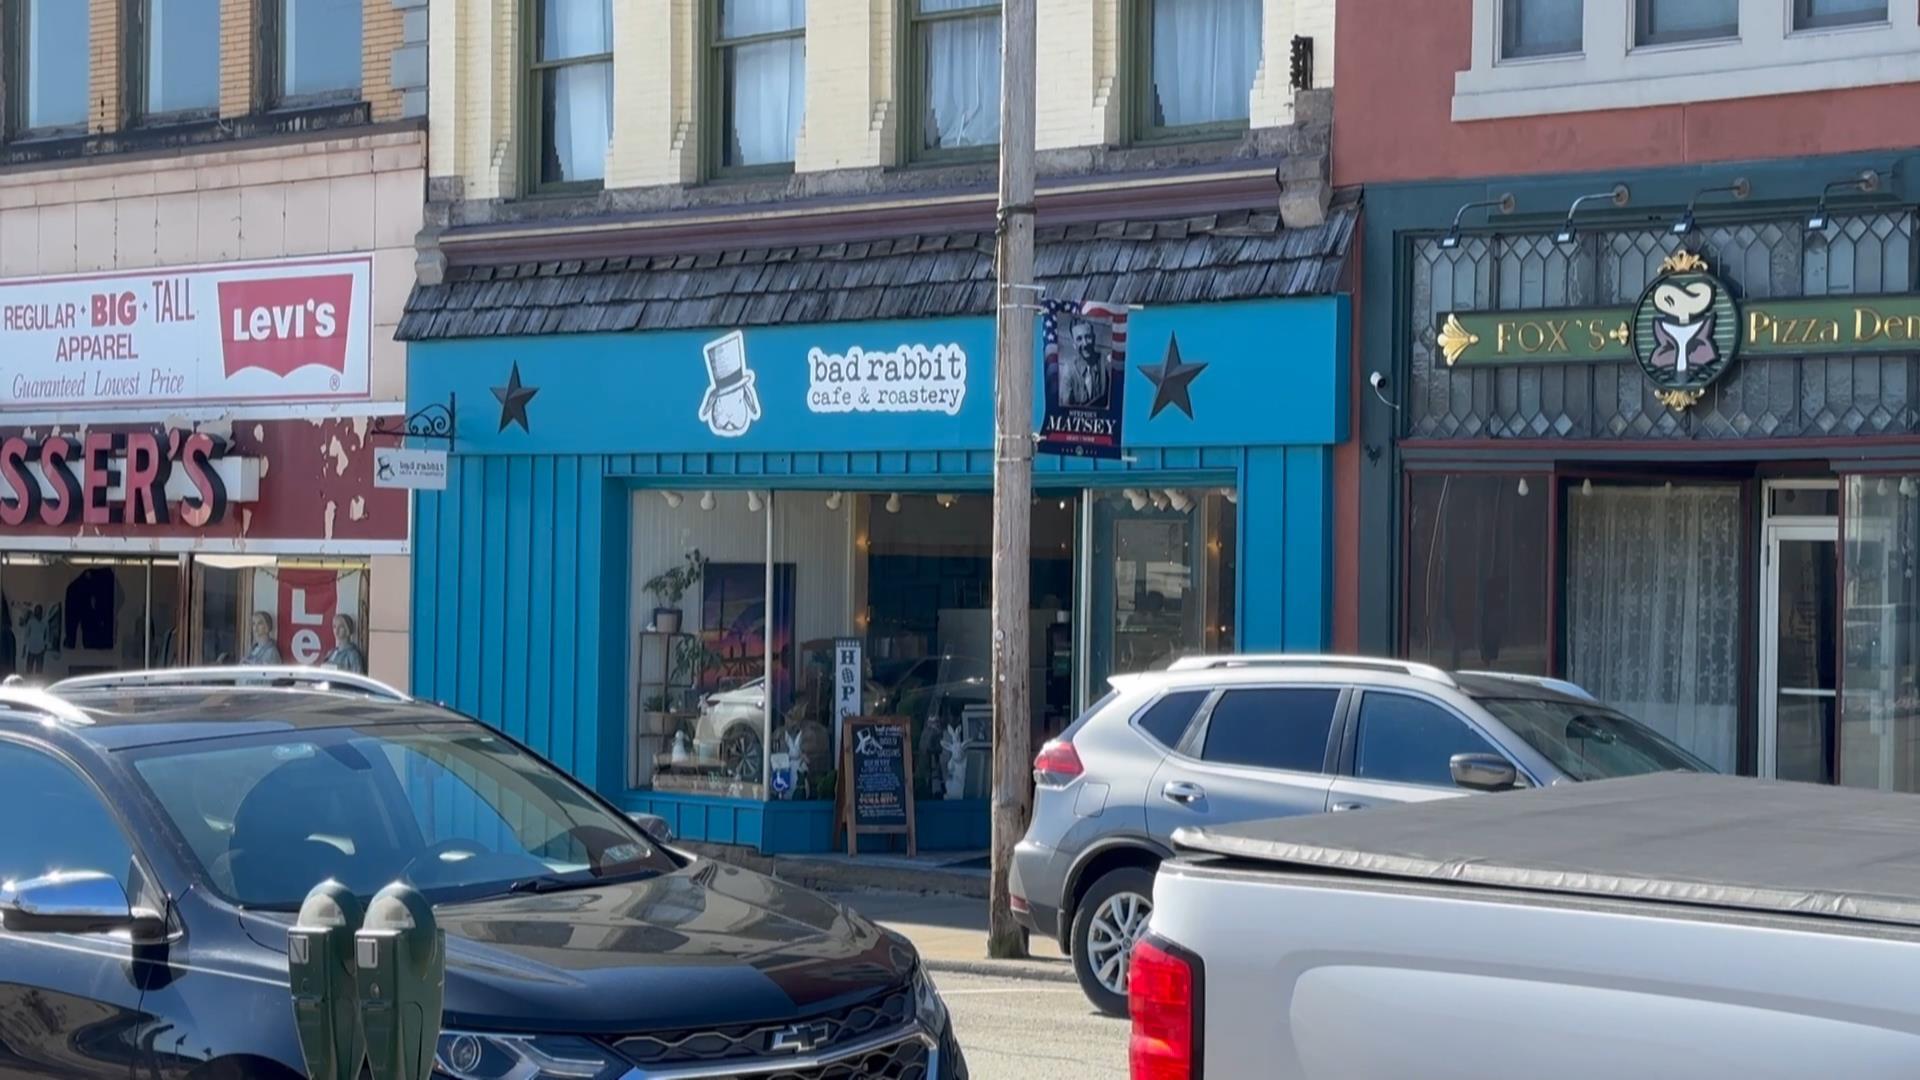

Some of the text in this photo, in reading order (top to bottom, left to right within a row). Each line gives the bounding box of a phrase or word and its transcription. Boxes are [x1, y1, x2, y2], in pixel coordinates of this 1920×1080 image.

[4, 278, 195, 331] REGULAR BIG TALL
[1496, 319, 1606, 353] FOX'S
[1749, 311, 1839, 344] Pizza
[55, 333, 139, 362] APPAREL
[814, 351, 961, 382] bad rabbit
[12, 367, 185, 399] Guaranteed Lowest Price
[811, 384, 961, 409] cafe & roastery
[1046, 415, 1116, 435] MATSEY
[0, 427, 224, 527] SSER'S
